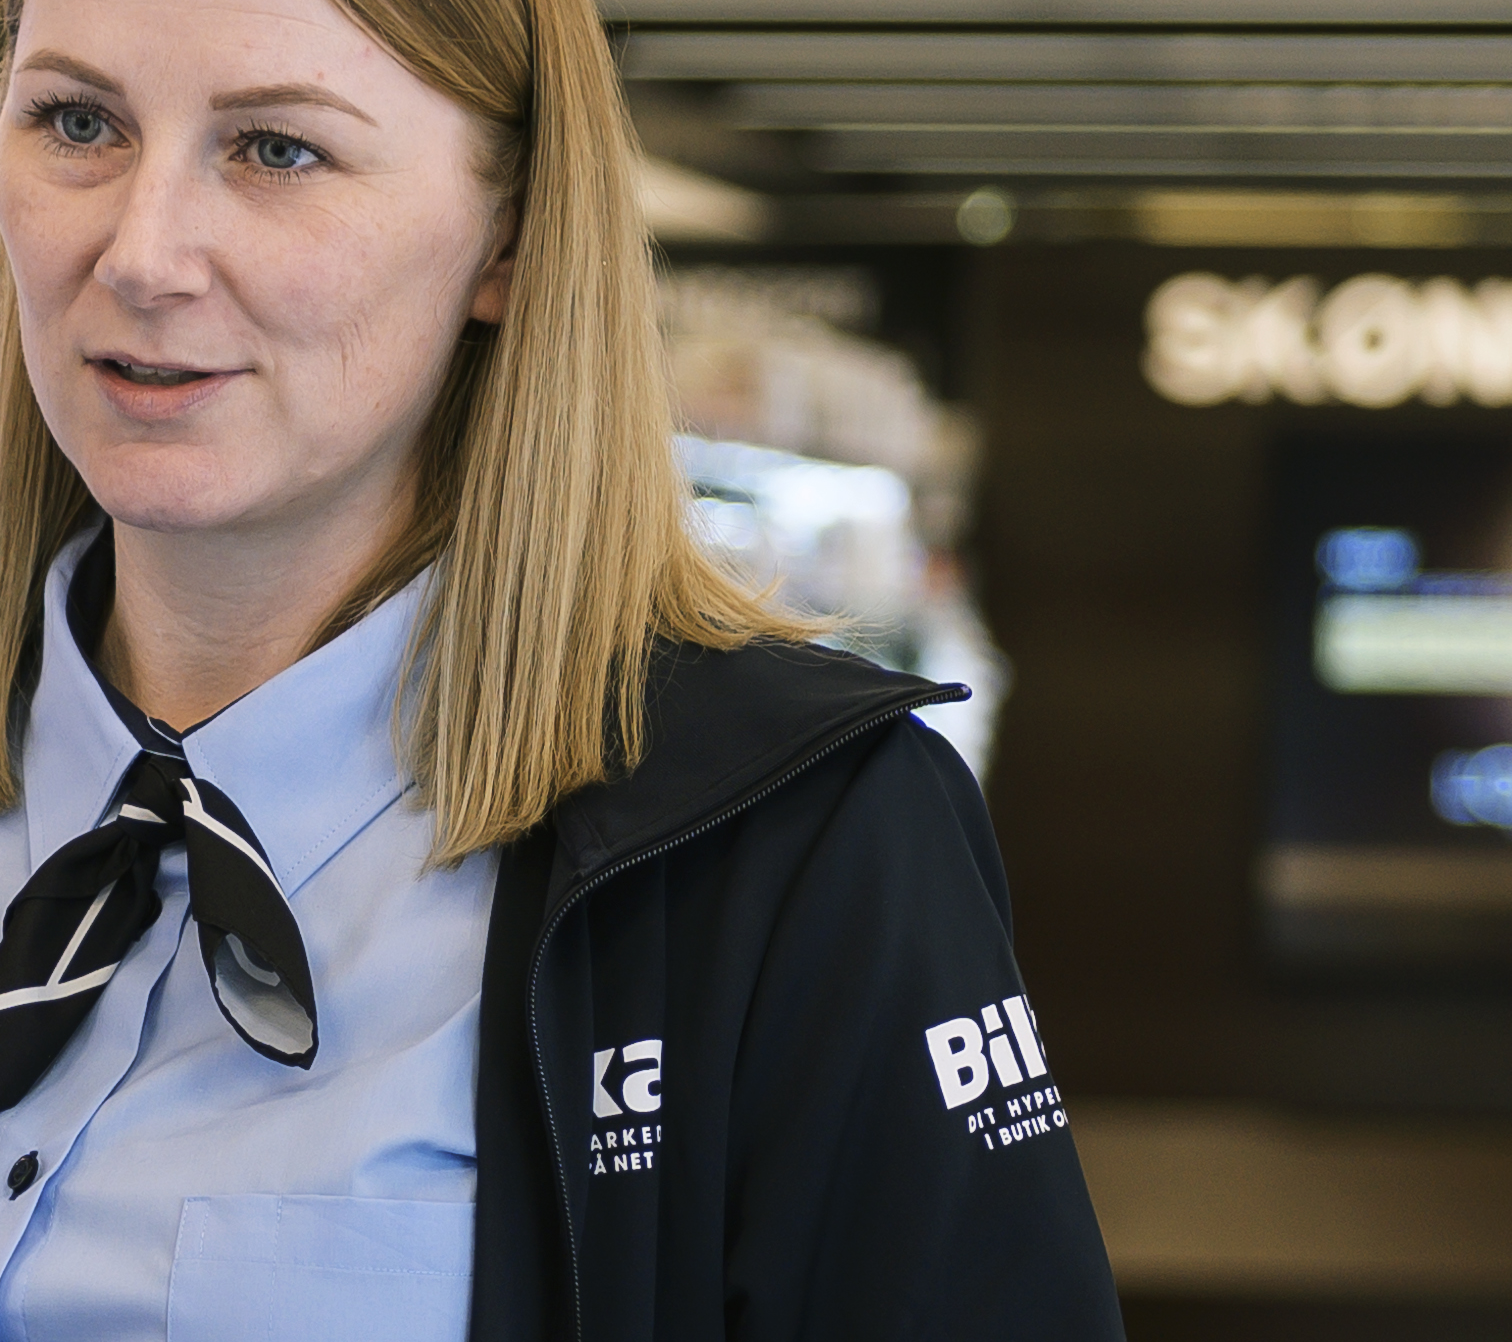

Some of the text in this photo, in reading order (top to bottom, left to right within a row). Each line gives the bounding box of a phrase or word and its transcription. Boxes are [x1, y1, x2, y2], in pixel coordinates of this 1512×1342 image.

[925, 994, 1048, 1110] Bil
[968, 1107, 995, 1134] DIT
[984, 1108, 1070, 1150] I BUTIK O
[614, 1151, 654, 1172] NET
